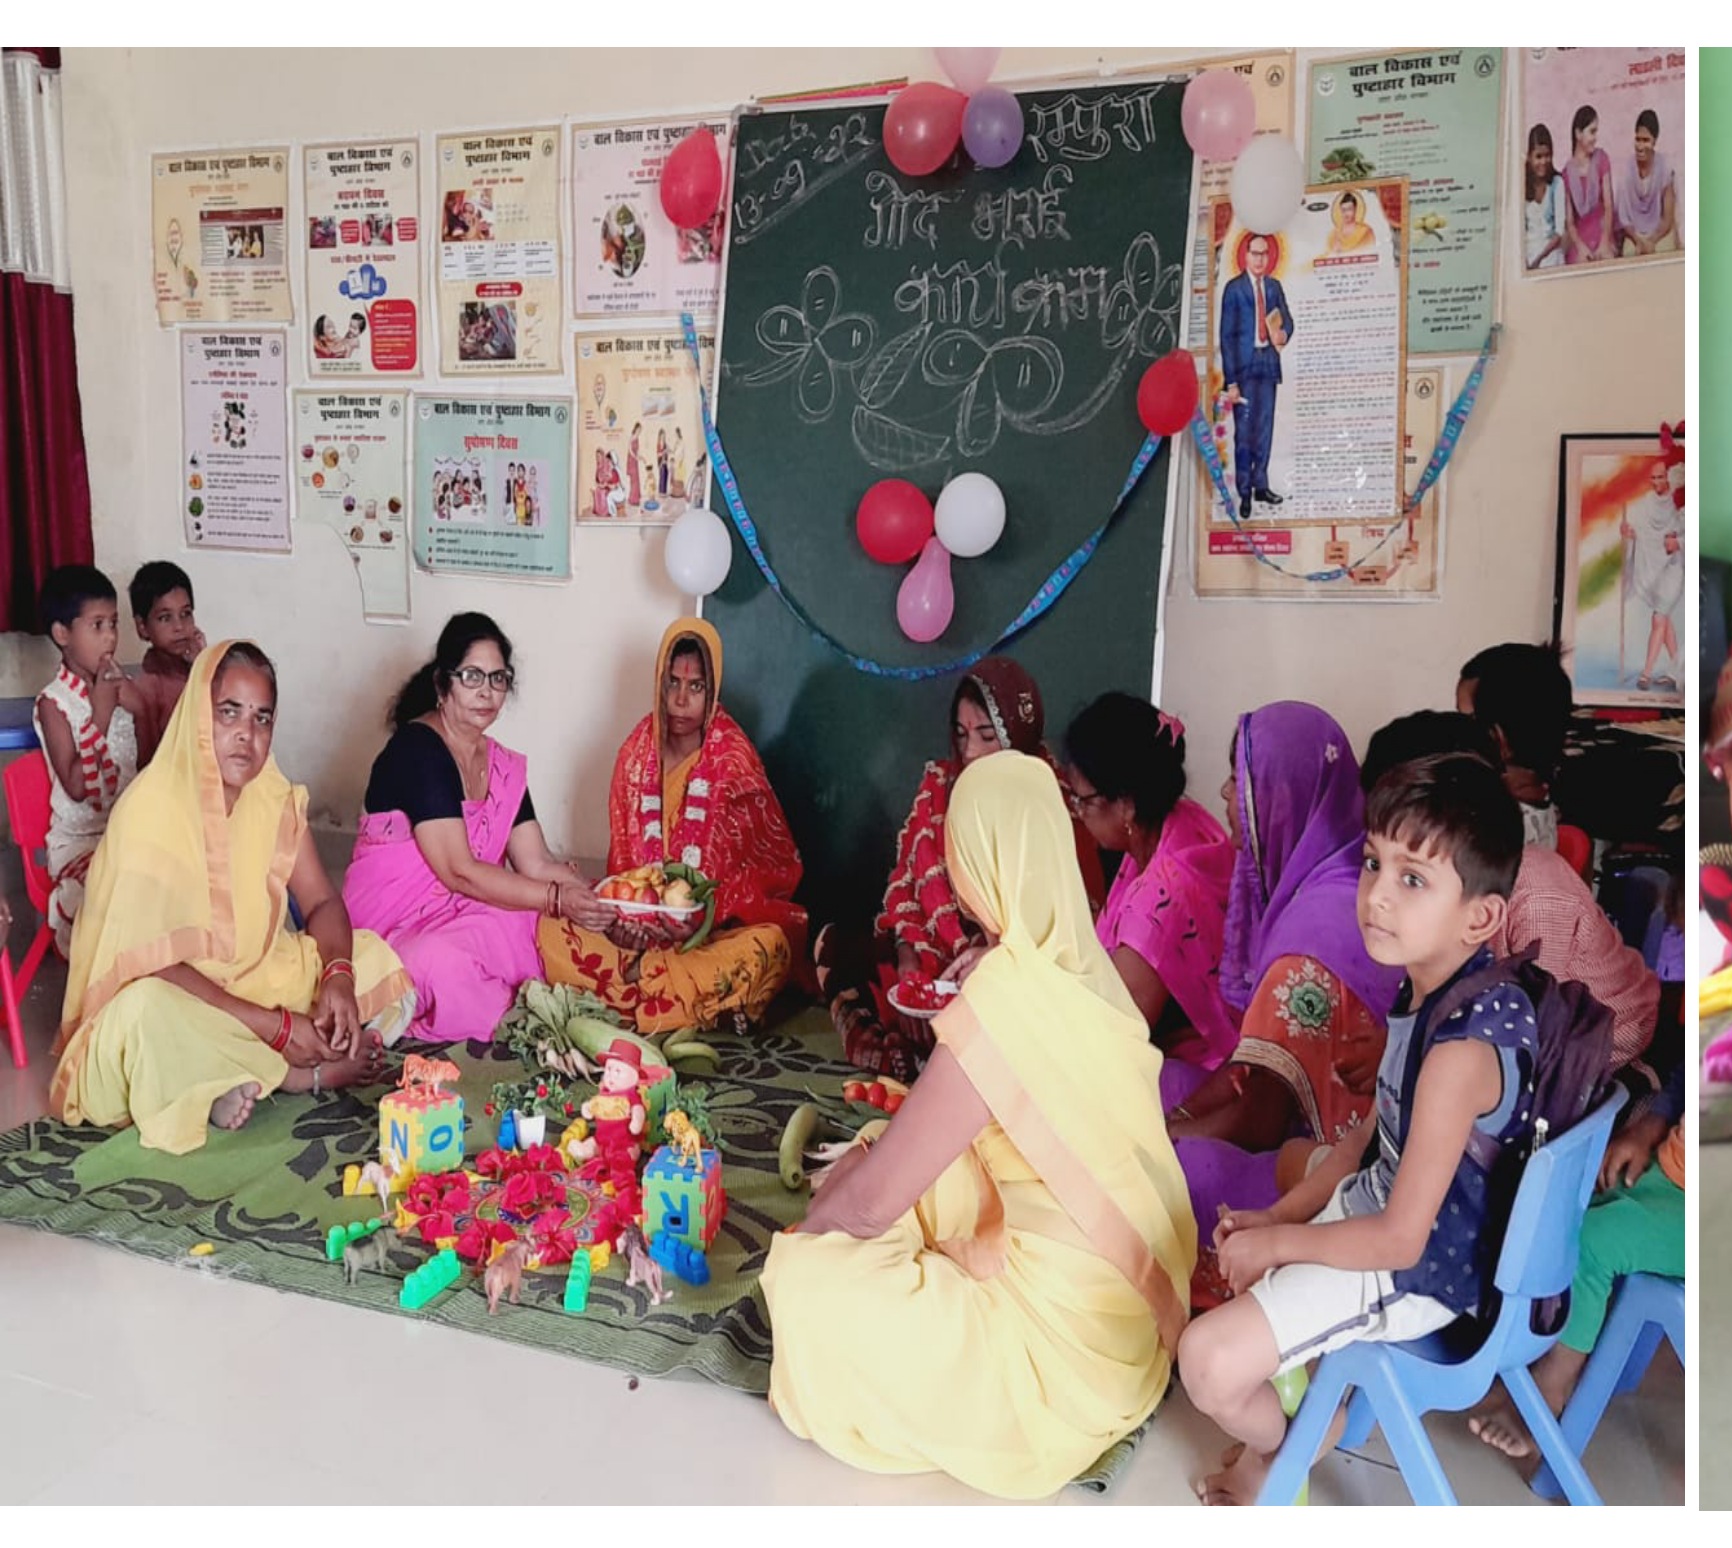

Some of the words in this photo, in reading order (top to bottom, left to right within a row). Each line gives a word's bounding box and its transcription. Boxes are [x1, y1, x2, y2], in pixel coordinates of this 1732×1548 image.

[1349, 63, 1379, 78] बाल
[1385, 56, 1433, 74] विकास
[1438, 51, 1463, 67] एवं
[1666, 53, 1685, 69] दिव
[1353, 78, 1405, 98] पुष्टाहार
[1411, 72, 1457, 88] विभाग
[594, 132, 612, 146] बाल
[615, 128, 643, 144] विकास
[647, 125, 660, 142] एवं
[863, 170, 962, 250] गोद
[433, 403, 450, 416] बाल
[452, 401, 478, 415] विकास
[526, 402, 552, 418] विभाग
[497, 433, 519, 451] दिवस
[390, 1119, 408, 1161] N
